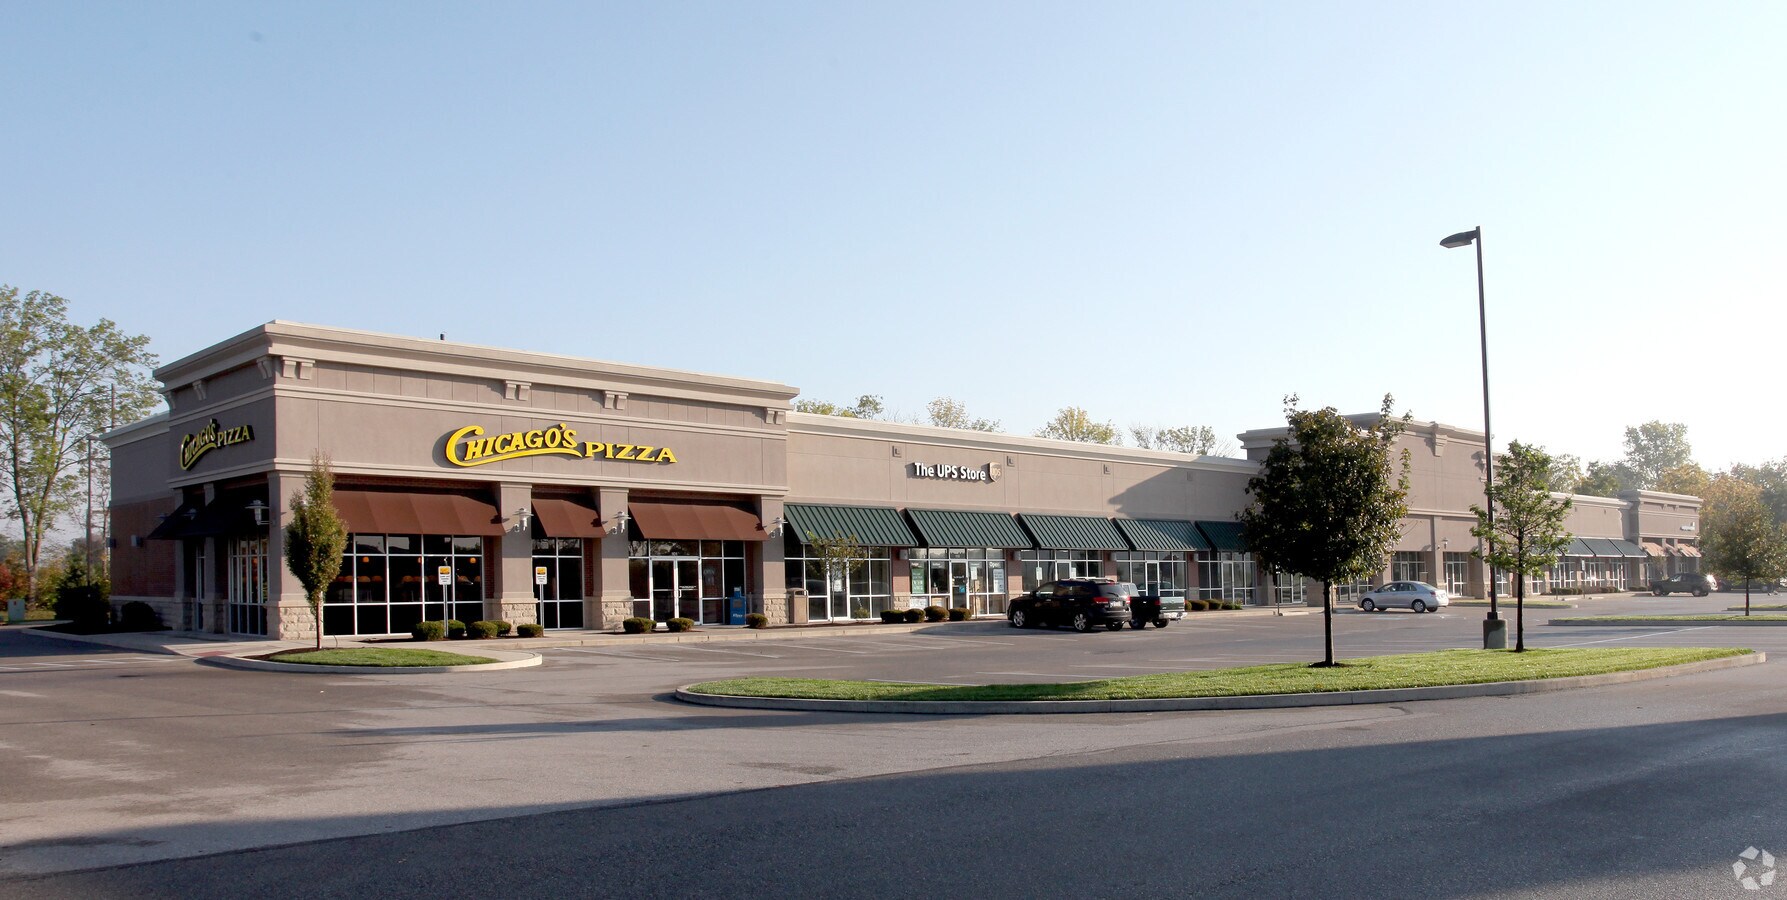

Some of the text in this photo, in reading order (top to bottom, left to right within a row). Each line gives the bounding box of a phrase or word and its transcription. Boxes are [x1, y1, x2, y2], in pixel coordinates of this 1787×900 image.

[181, 418, 250, 470] CHICAGO'S PIZZA
[446, 423, 678, 467] CHICAGO'S PIZZA
[915, 462, 986, 480] The UPS Store
